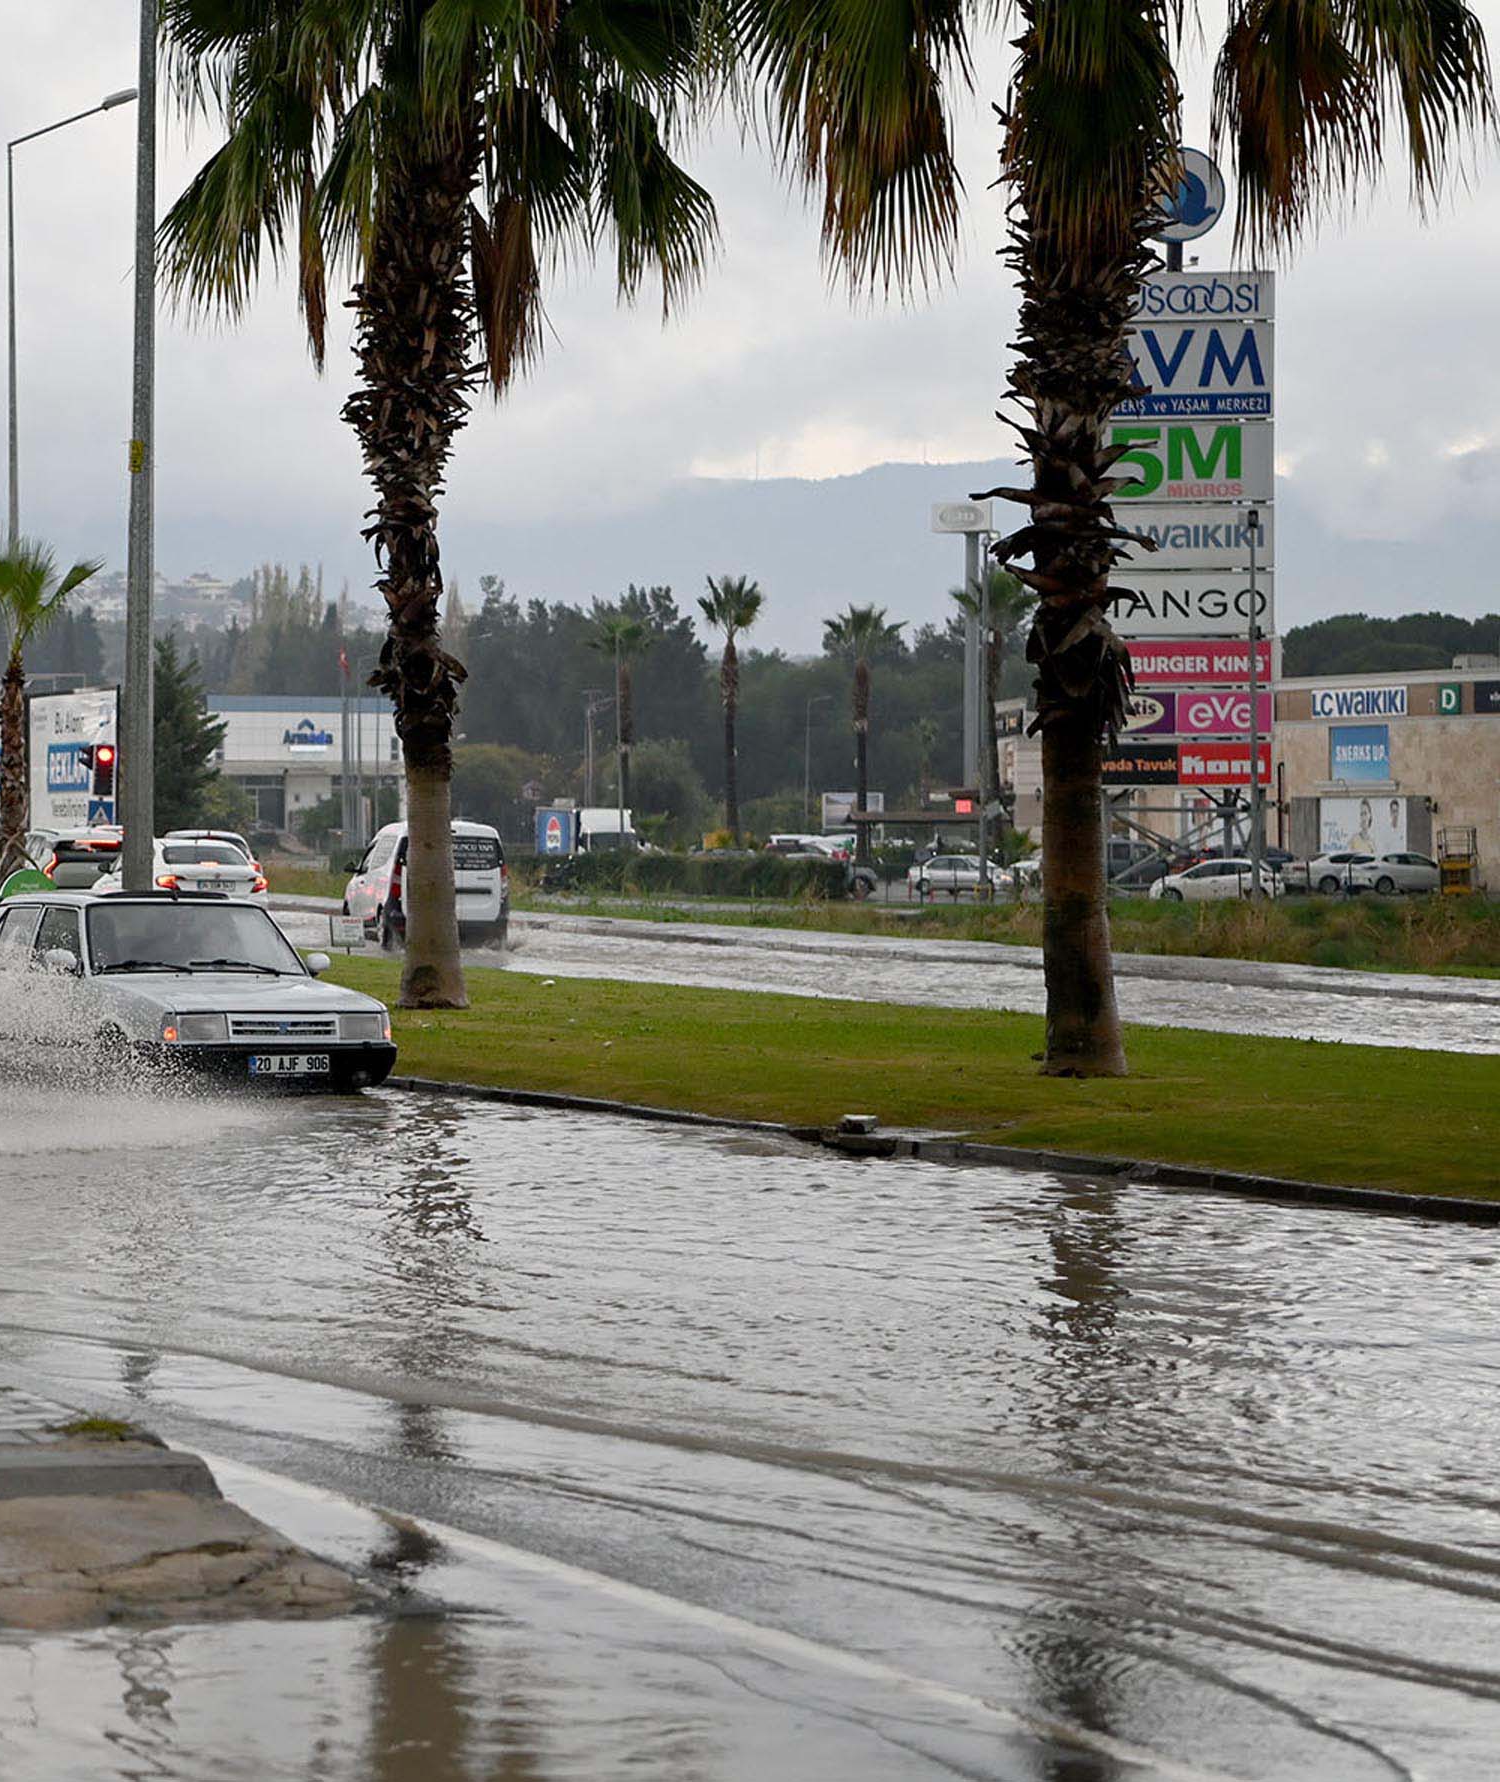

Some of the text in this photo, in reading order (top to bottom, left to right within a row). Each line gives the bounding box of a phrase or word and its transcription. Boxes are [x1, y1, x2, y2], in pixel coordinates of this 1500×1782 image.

[1172, 399, 1210, 414] YAŞAM
[1216, 396, 1268, 411] MERKEZİ
[1111, 426, 1242, 498] 5M
[1113, 589, 1267, 618] ANGO
[1131, 656, 1265, 673] BURGER KING
[1311, 692, 1333, 717] LC
[1440, 689, 1456, 710] D
[283, 729, 333, 745] Armada
[1101, 758, 1133, 771] vada
[257, 1056, 328, 1071] 20 AJF 906
